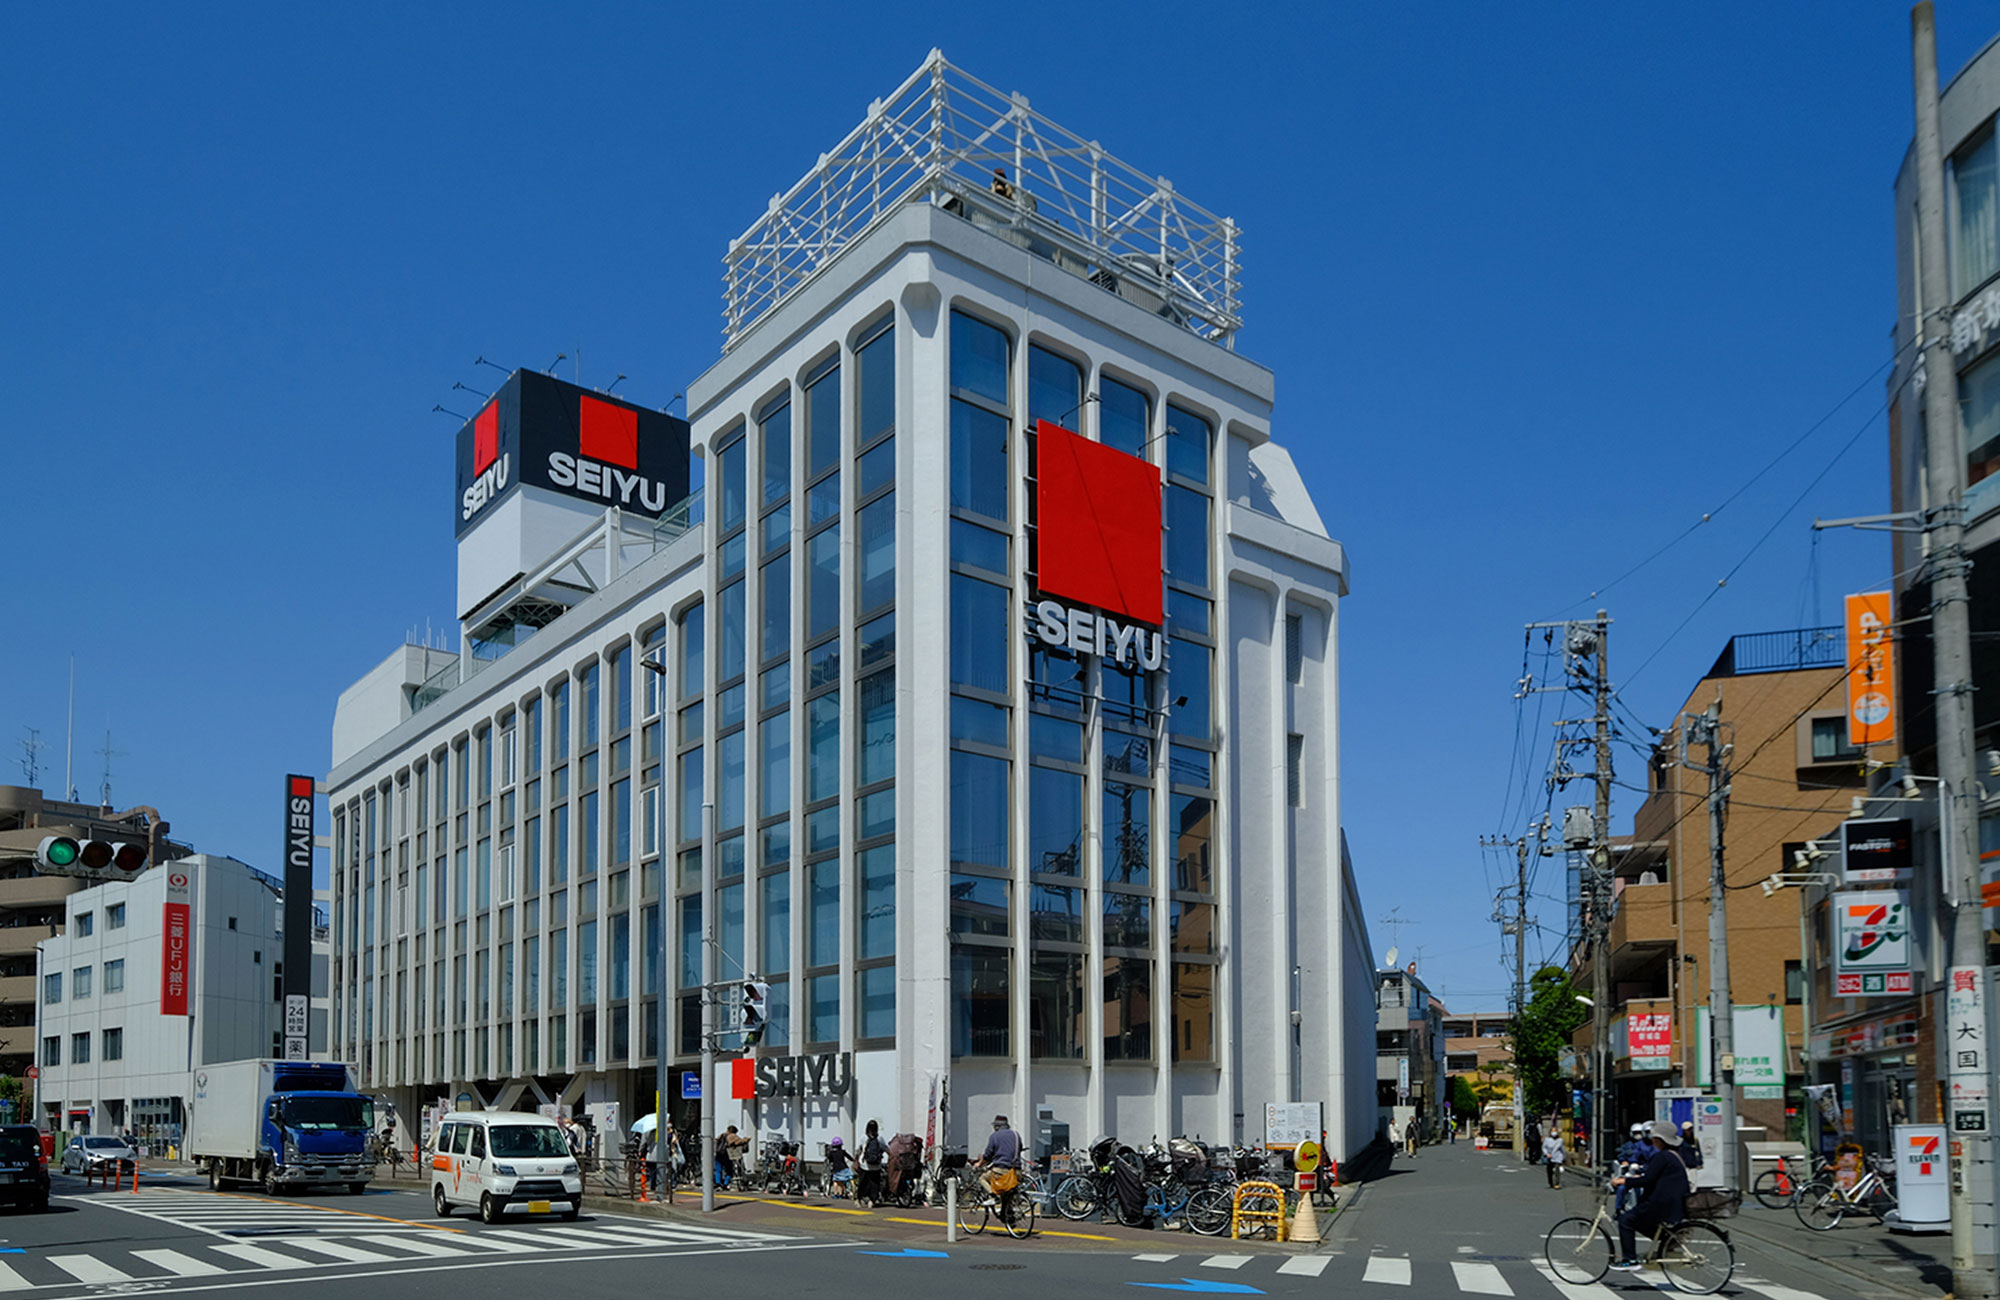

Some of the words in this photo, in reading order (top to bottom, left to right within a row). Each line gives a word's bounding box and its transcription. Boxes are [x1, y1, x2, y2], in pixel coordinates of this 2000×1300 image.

[462, 452, 510, 521] SEIYU
[548, 451, 666, 512] SEIYU
[1037, 600, 1163, 672] SEIYU
[290, 798, 311, 867] SEIYU
[169, 912, 184, 997] 三菱UFJ銀行
[1865, 976, 1882, 990] 酒
[1888, 975, 1910, 989] ATM
[1953, 970, 1978, 992] 質
[288, 1006, 304, 1016] 24
[288, 1040, 303, 1053] 薬
[1956, 1021, 1979, 1068] 大国
[755, 1052, 851, 1098] SEIYU
